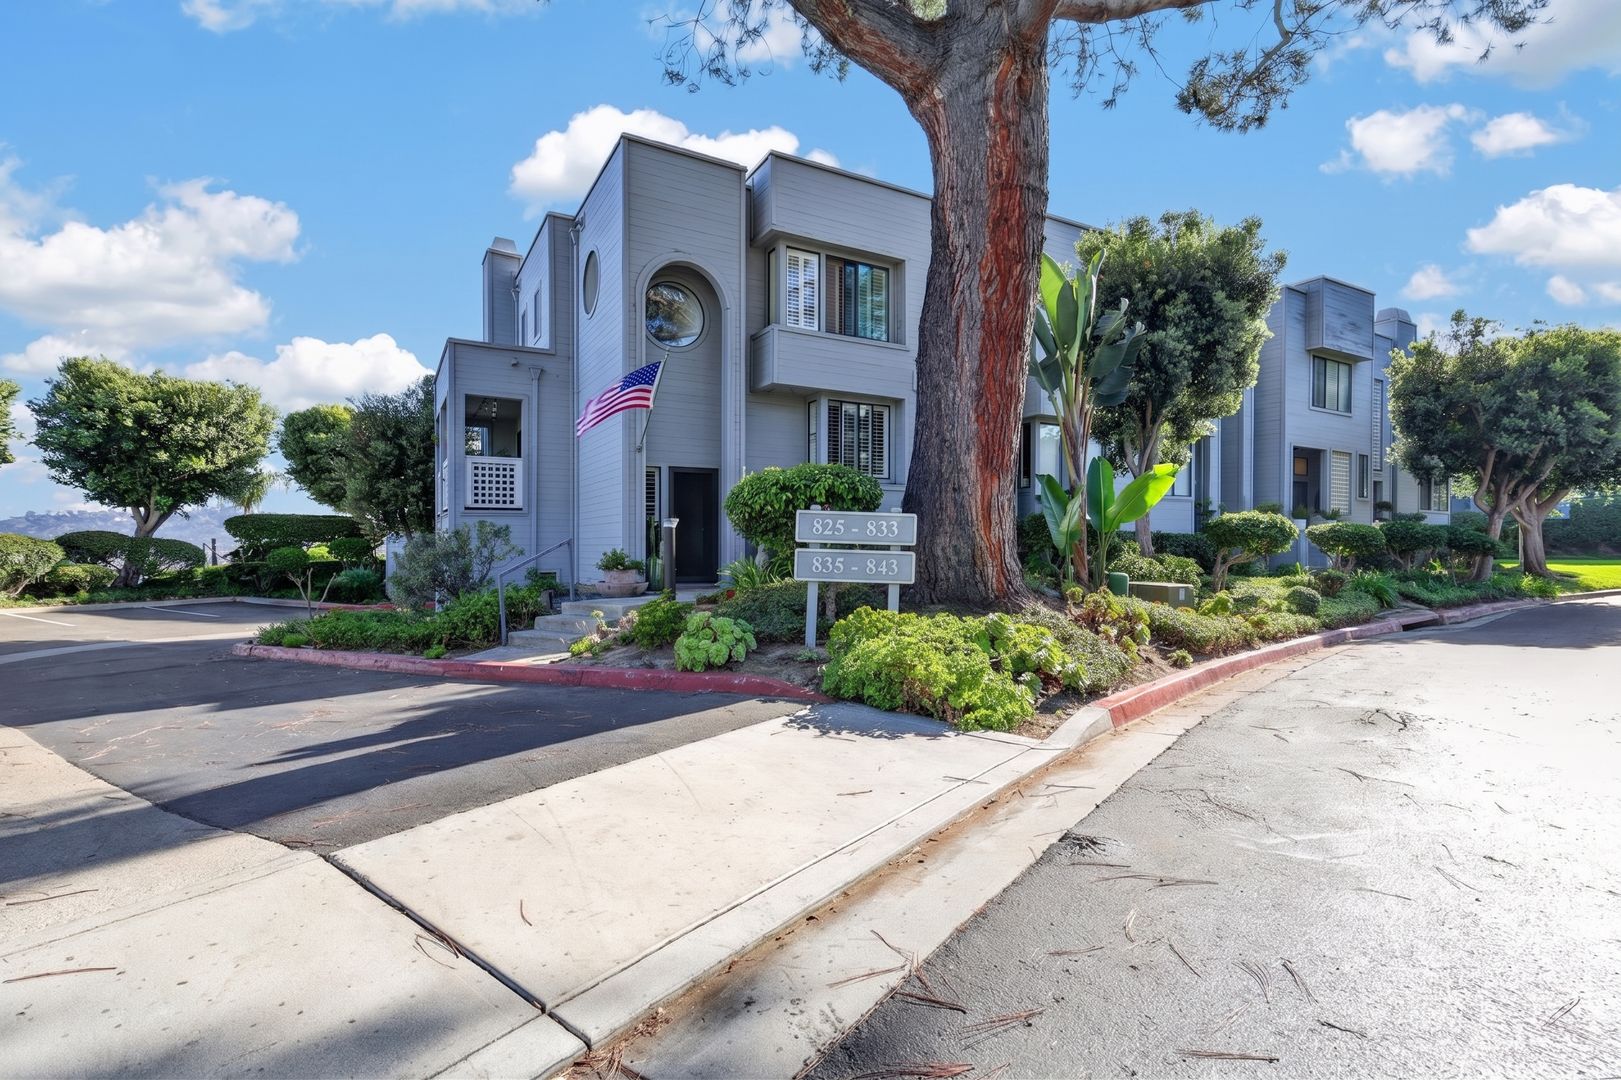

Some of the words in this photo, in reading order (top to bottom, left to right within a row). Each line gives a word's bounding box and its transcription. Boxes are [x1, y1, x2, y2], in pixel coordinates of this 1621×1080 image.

[812, 518, 845, 535] 825
[866, 520, 899, 537] 833
[812, 556, 844, 574] 835
[866, 558, 898, 575] 843
